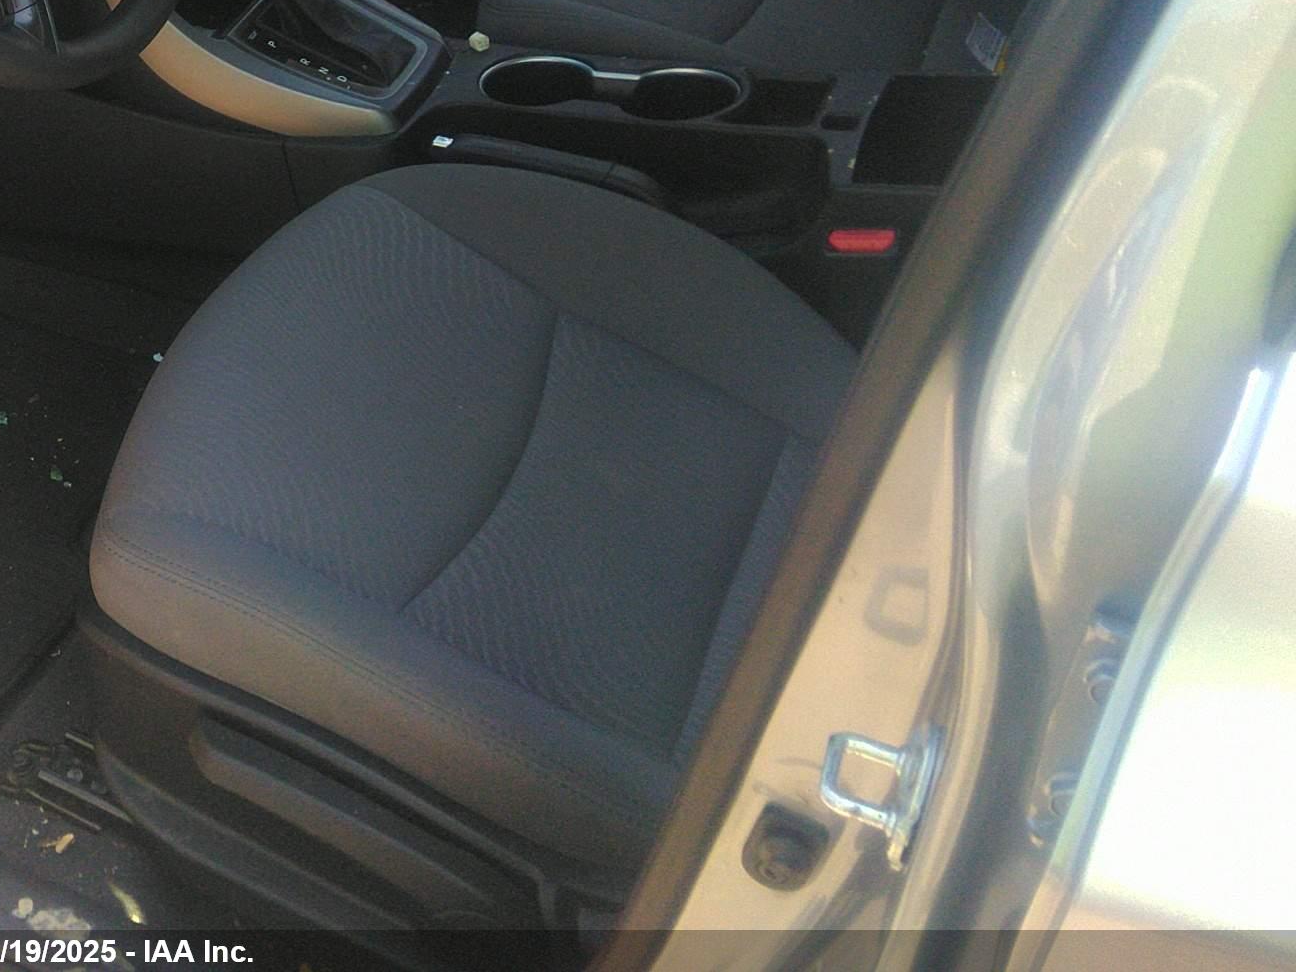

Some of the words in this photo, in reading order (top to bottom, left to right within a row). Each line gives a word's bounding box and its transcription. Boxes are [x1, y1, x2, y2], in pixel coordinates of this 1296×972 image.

[267, 40, 276, 48] P
[299, 58, 311, 66] R
[318, 66, 330, 75] N
[337, 75, 347, 83] D
